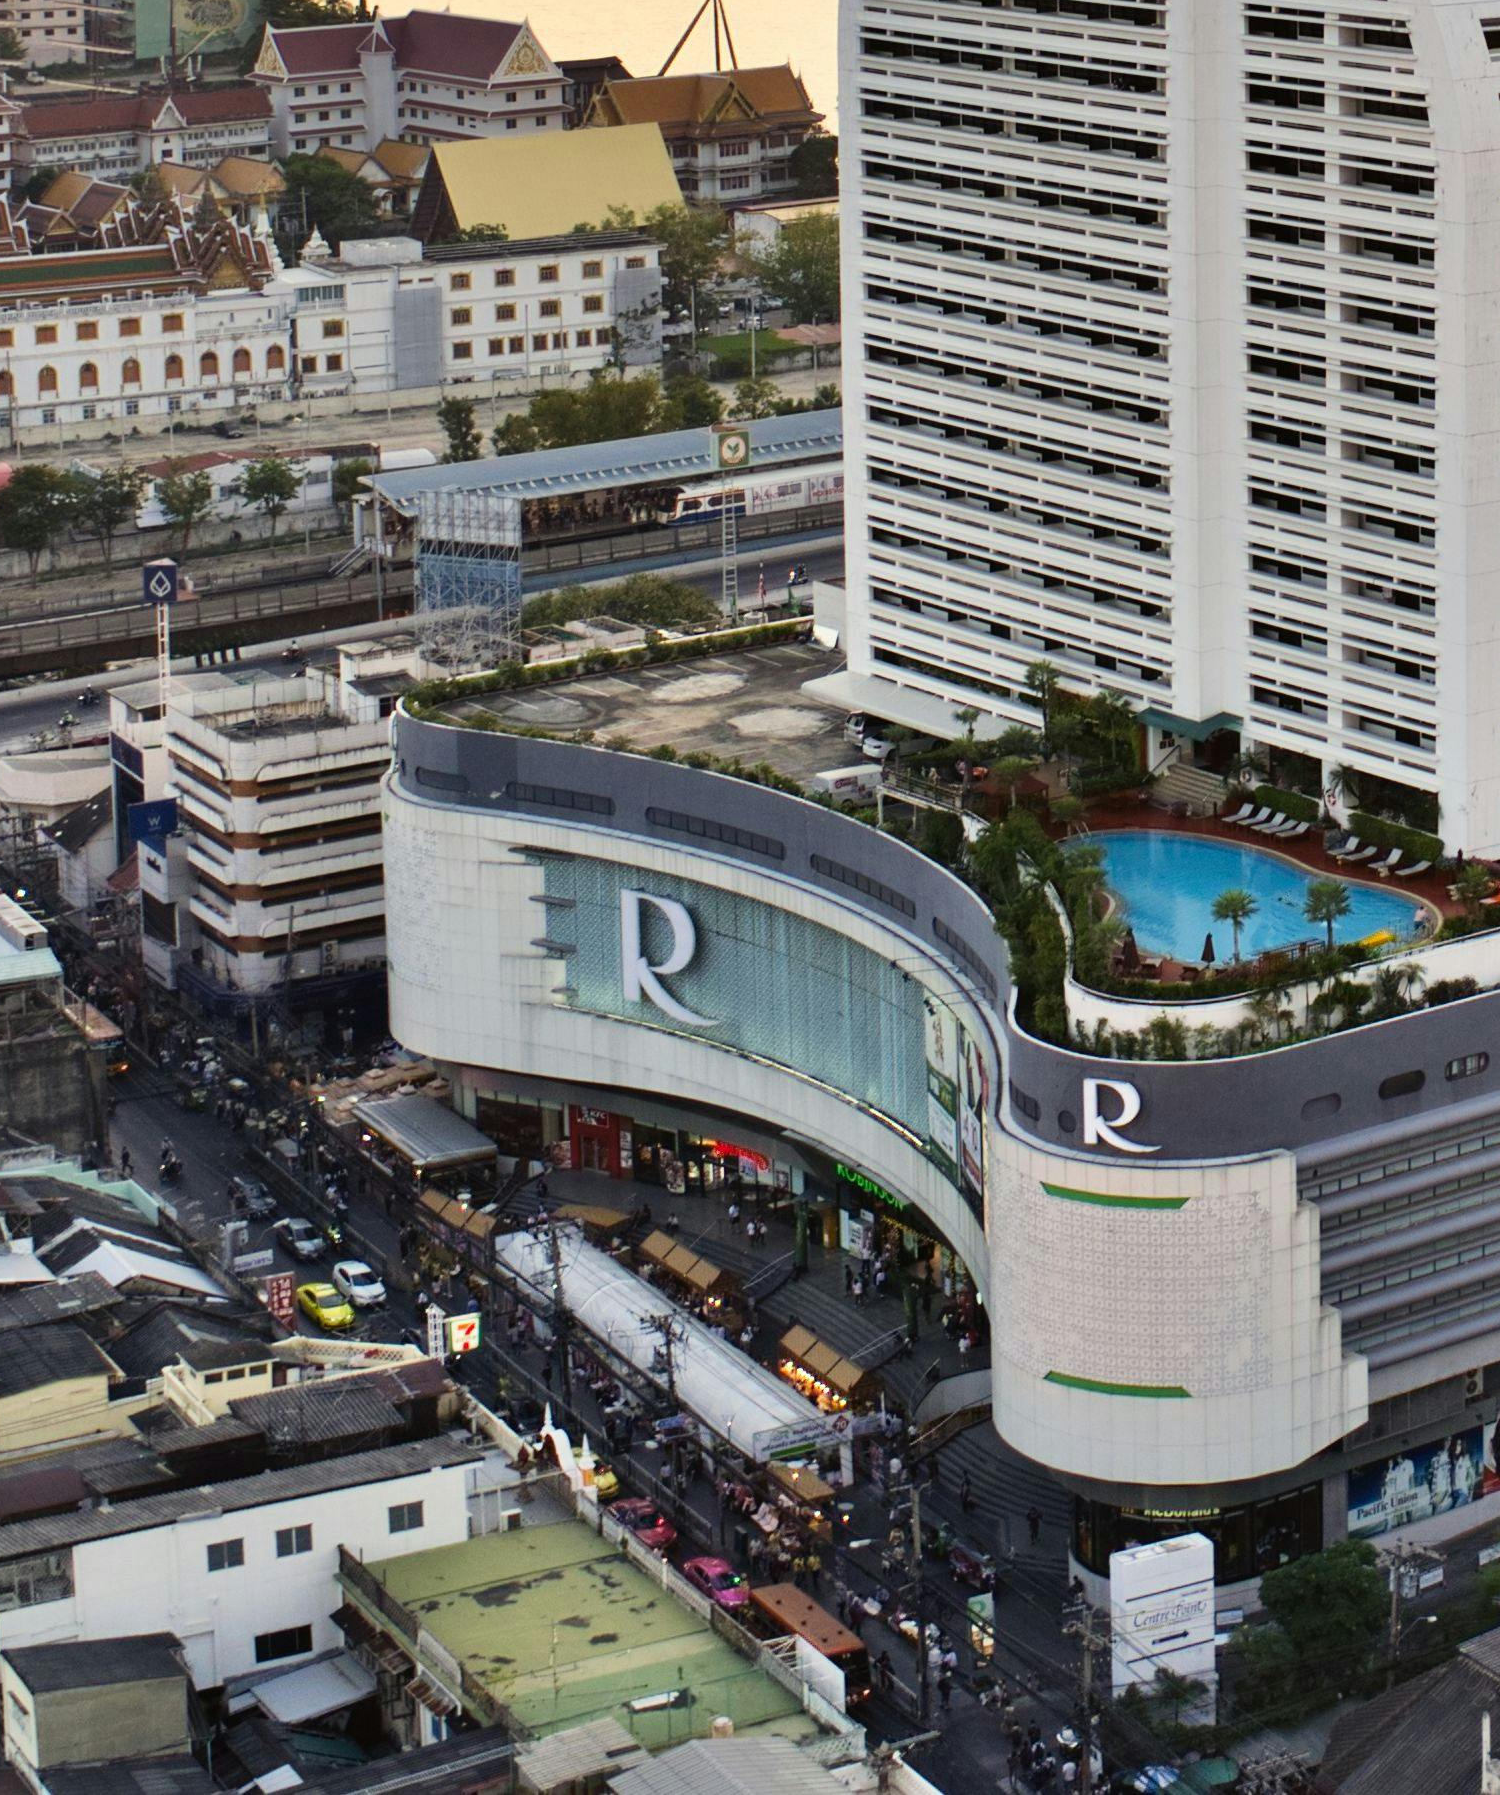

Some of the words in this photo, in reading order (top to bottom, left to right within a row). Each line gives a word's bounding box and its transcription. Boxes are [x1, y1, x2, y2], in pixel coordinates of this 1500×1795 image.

[620, 887, 720, 1028] R
[1082, 1077, 1162, 1154] R
[1143, 1507, 1221, 1518] McDonalds
[1356, 1500, 1389, 1520] Pacific
[1390, 1491, 1419, 1508] Union
[1133, 1610, 1171, 1628] Centre
[1172, 1598, 1207, 1618] Point
